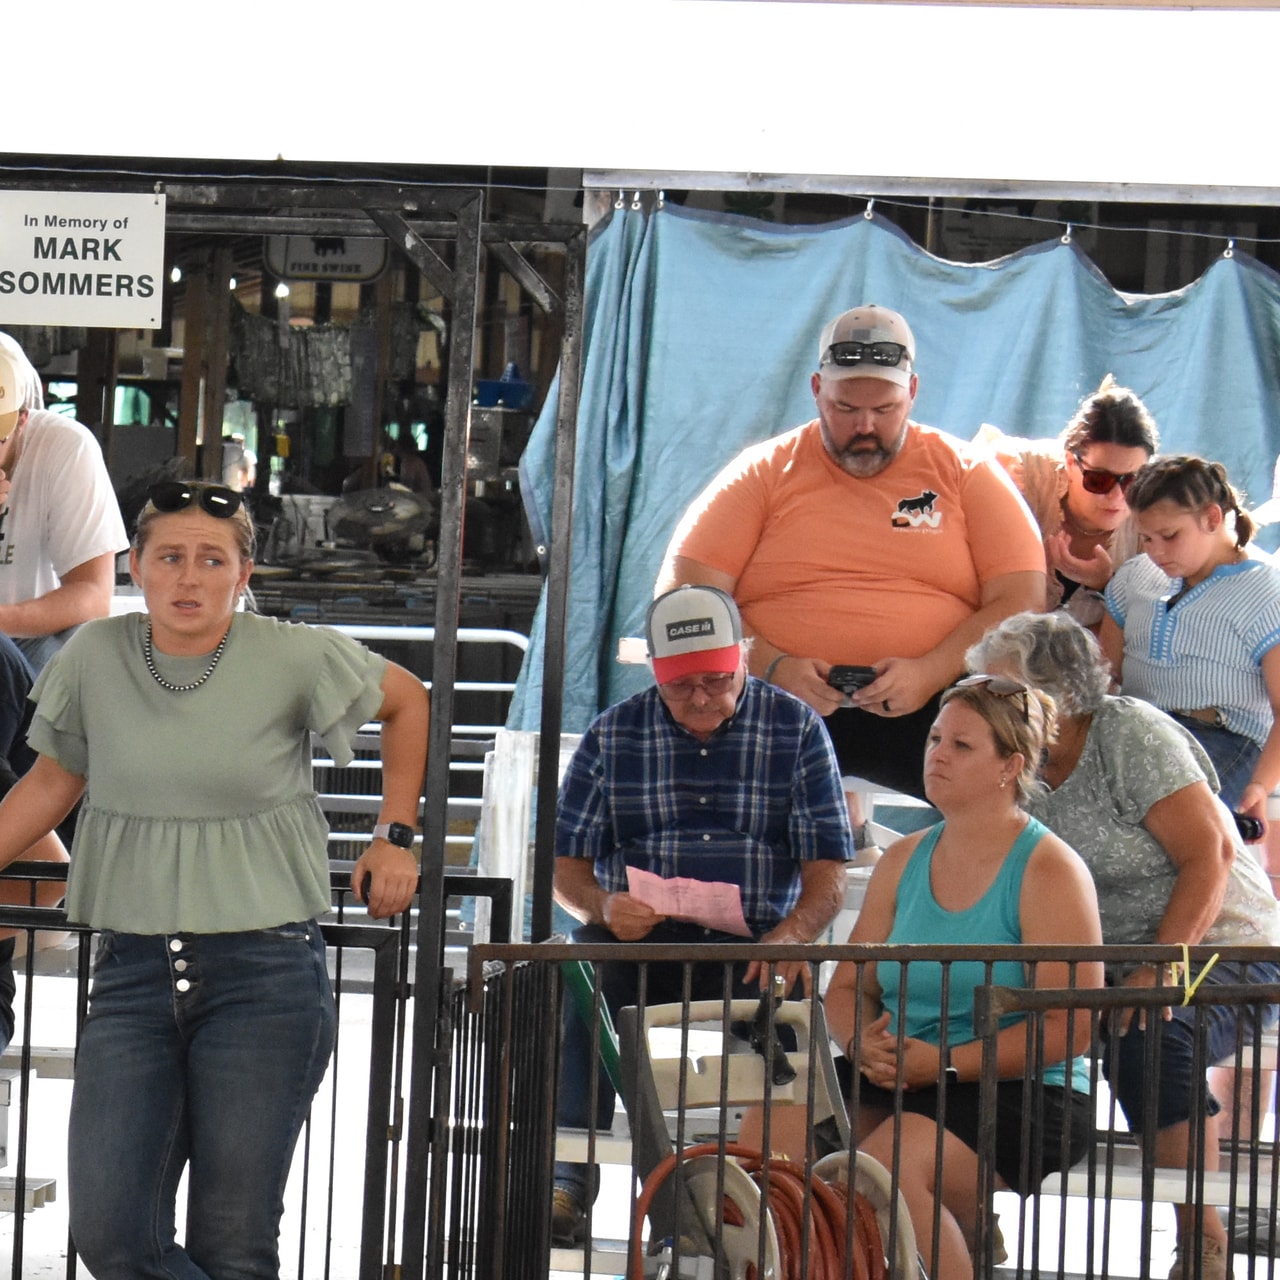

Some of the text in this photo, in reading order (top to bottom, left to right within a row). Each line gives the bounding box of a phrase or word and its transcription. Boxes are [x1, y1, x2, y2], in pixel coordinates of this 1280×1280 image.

[24, 214, 128, 232] In Memory of
[33, 236, 123, 261] MARK
[670, 624, 700, 637] CASE
